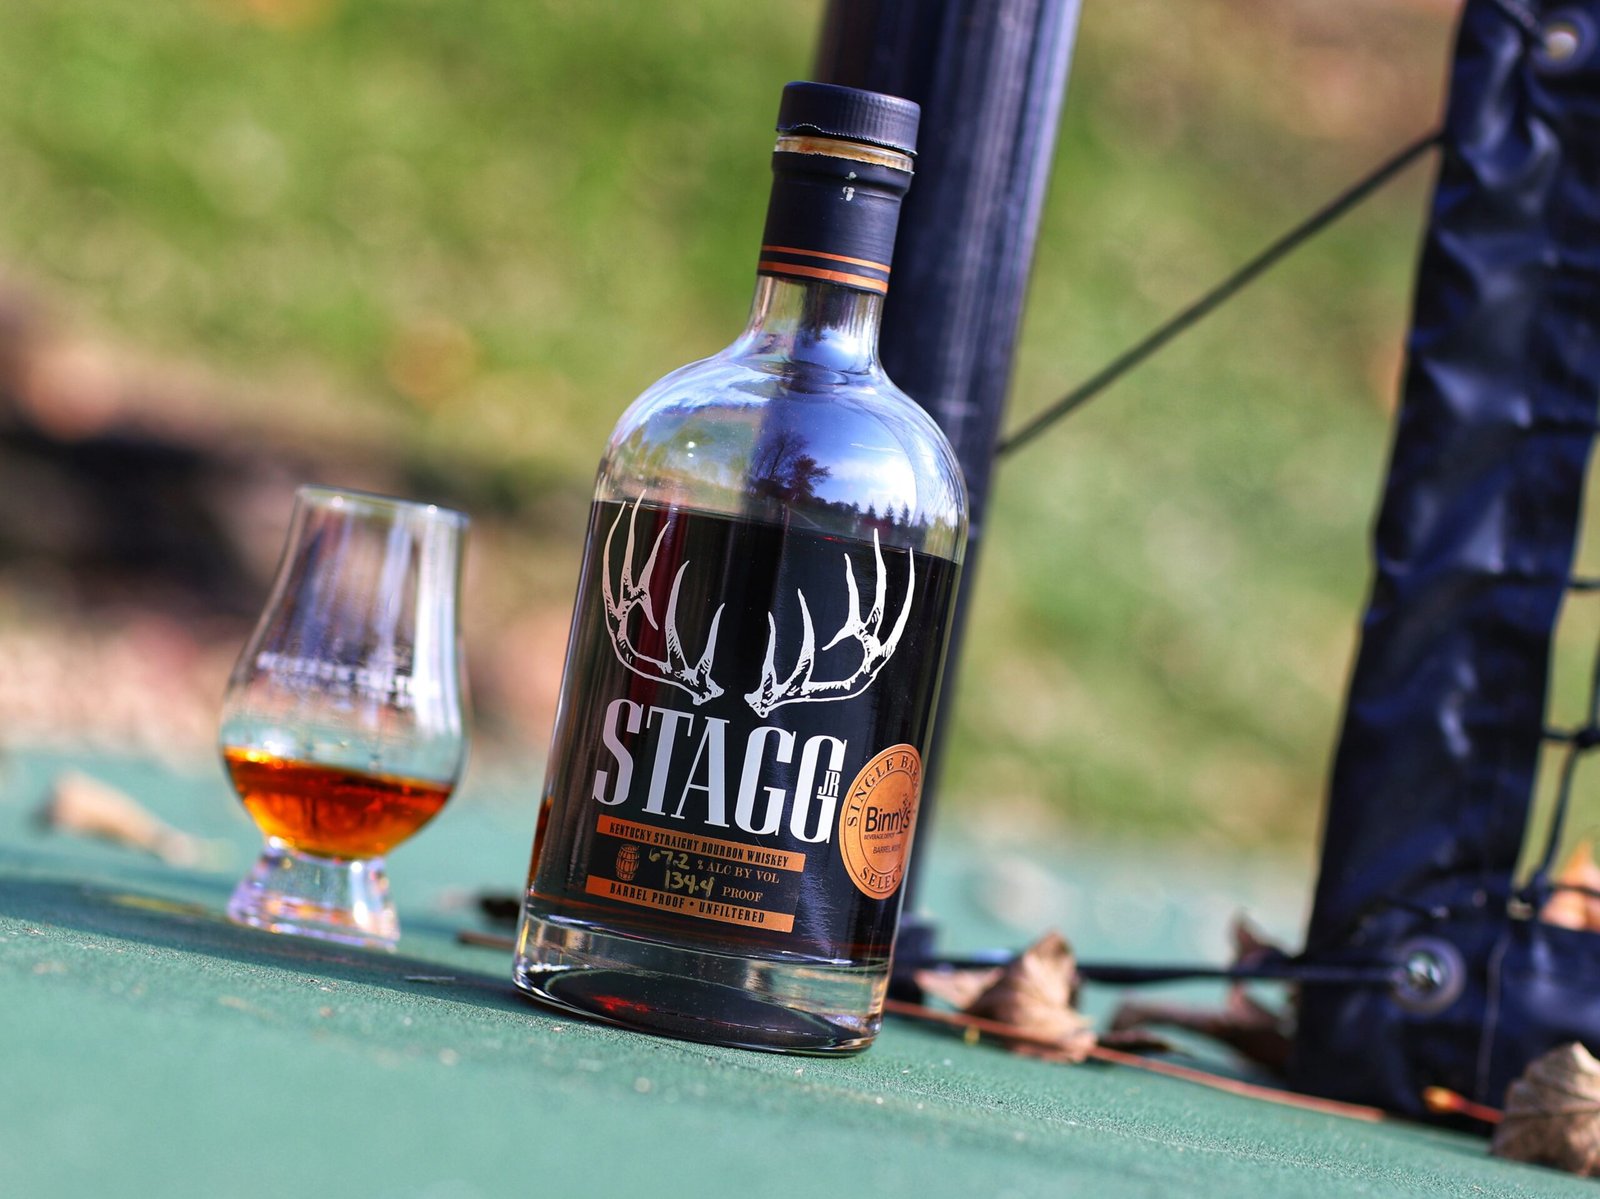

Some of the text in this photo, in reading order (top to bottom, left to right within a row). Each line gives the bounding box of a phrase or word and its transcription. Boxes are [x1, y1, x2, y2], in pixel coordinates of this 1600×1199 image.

[592, 699, 847, 844] STAGG
[817, 770, 840, 797] JR
[847, 757, 894, 827] SINGLE
[610, 822, 789, 867] KENTUCKY STRAIGHT BOURBON WHISKEY
[649, 847, 690, 870] 67.2
[707, 862, 731, 875] ALC
[734, 866, 752, 879] BY
[756, 870, 780, 884] VOL
[665, 869, 763, 902] 134.4 PROOF
[610, 882, 765, 923] BARREL PROOF UNFILTERED
